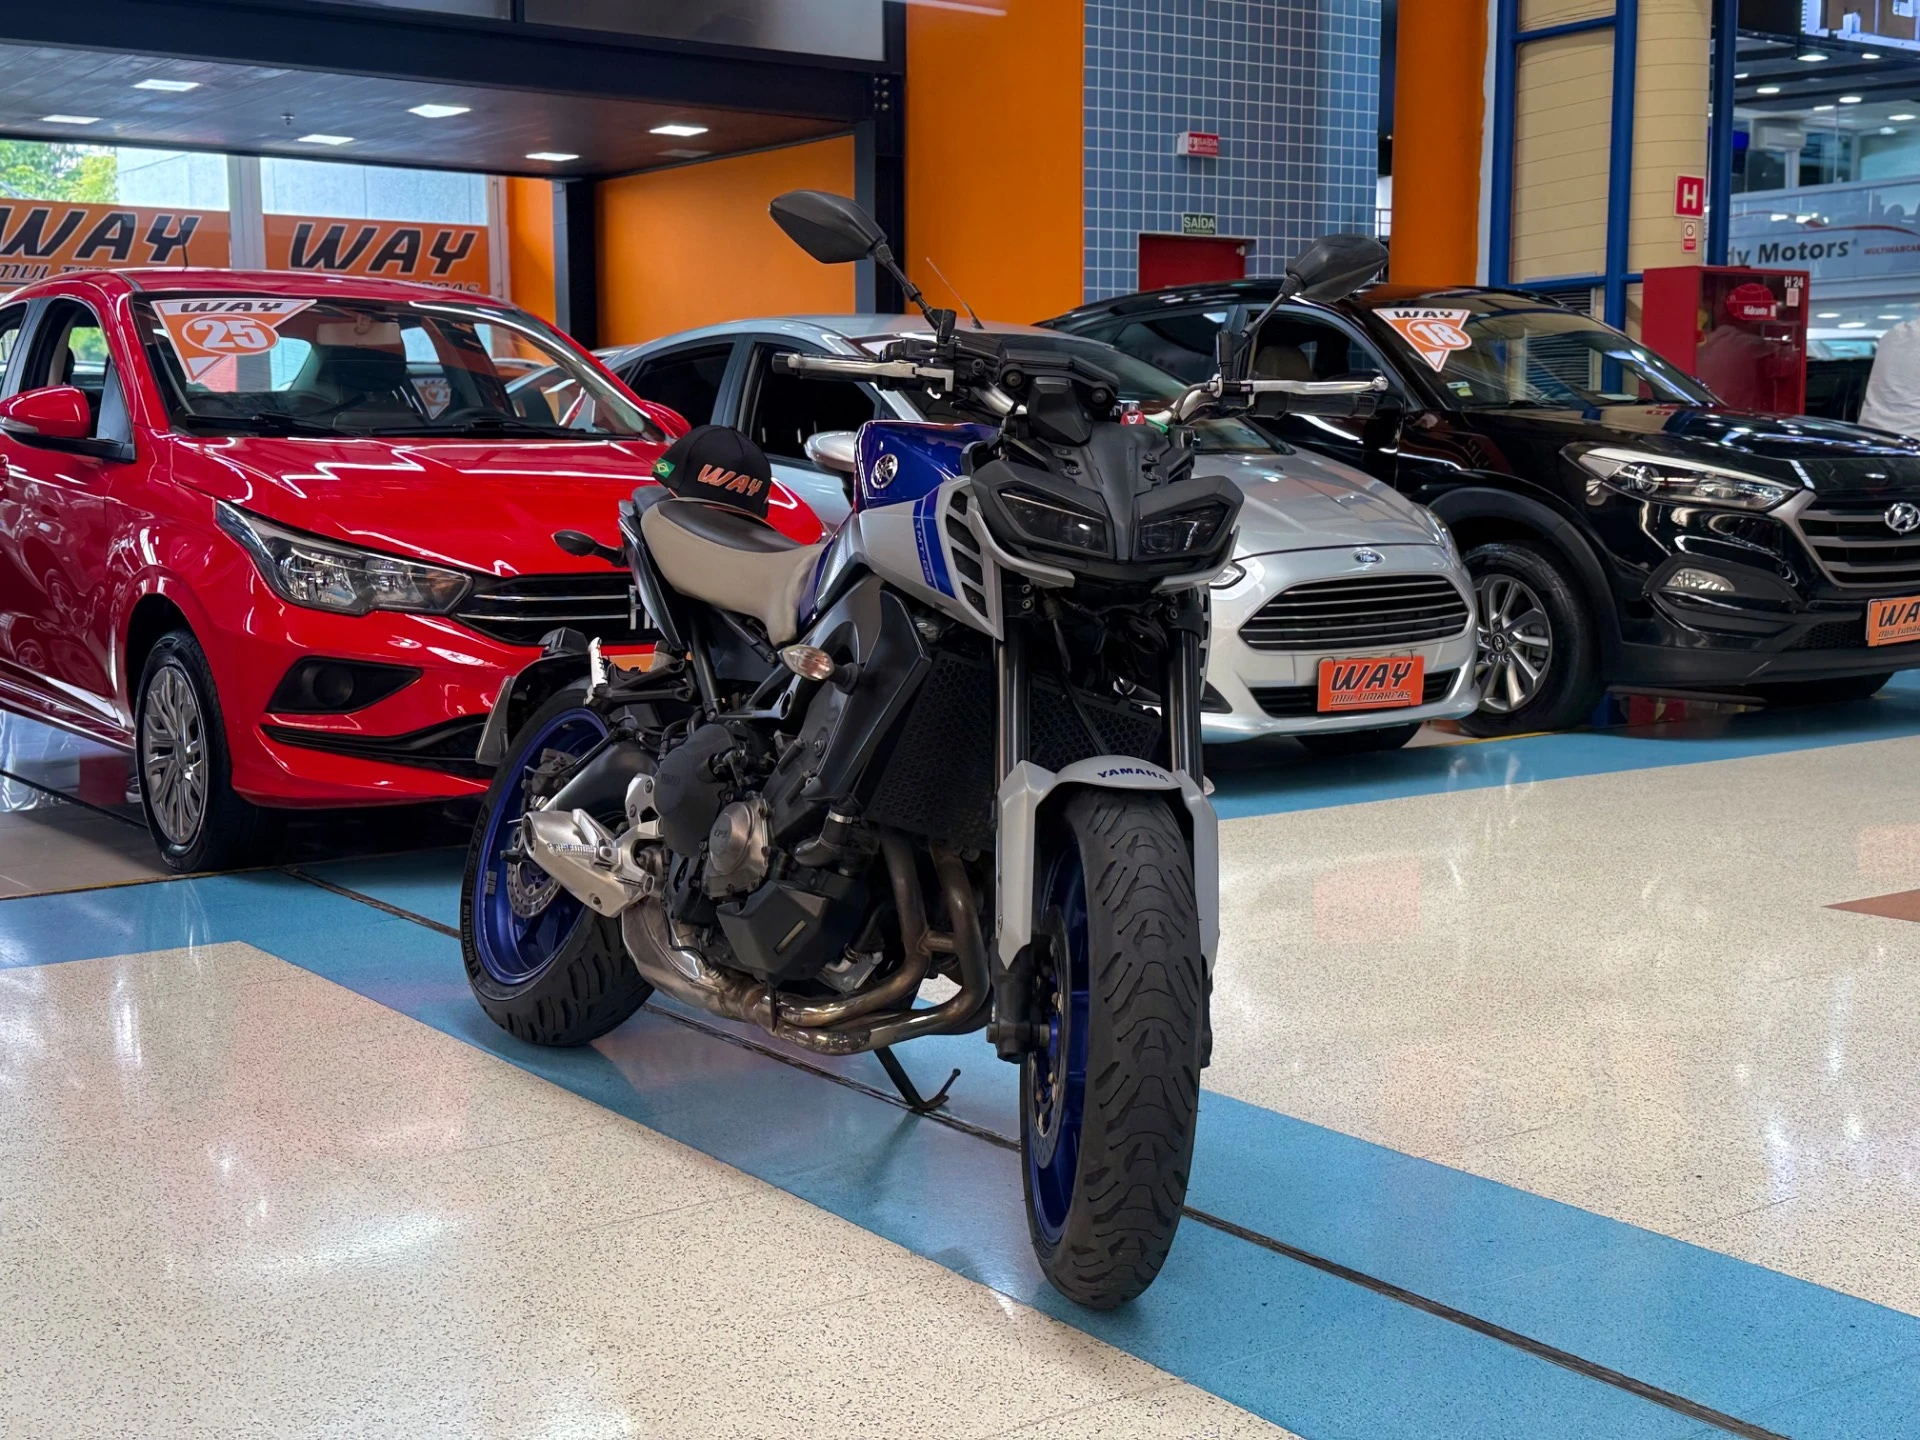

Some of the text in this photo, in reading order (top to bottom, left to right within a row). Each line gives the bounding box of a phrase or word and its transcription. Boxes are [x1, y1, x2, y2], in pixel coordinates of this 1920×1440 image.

[1682, 183, 1698, 209] H
[0, 206, 201, 263] WAY
[289, 222, 479, 276] WAY
[1757, 240, 1849, 264] Motors
[1784, 276, 1804, 289] H 24
[181, 302, 283, 313] WAY
[1394, 310, 1453, 318] WAY
[193, 320, 268, 348] 25
[1412, 323, 1466, 346] 18
[697, 463, 763, 497] WAY
[1879, 601, 1920, 628] WA
[1331, 661, 1414, 691] WAY
[1097, 768, 1169, 782] YAMAHA
[463, 905, 476, 962] MICHELIN
